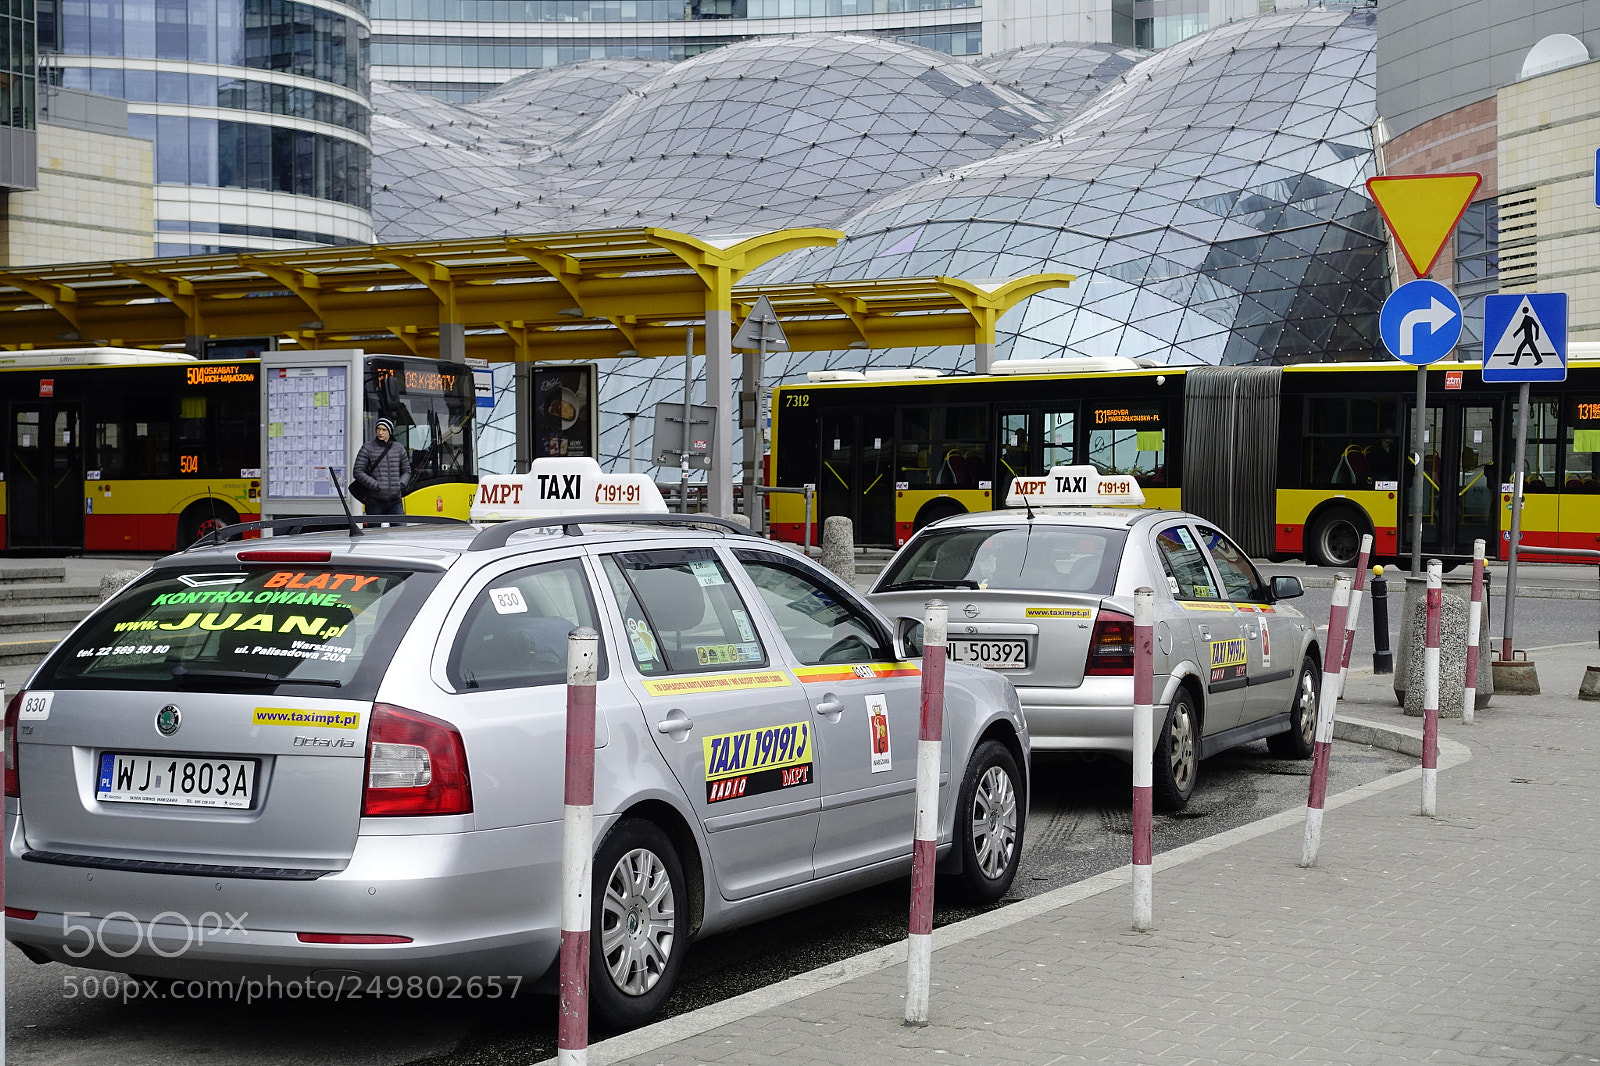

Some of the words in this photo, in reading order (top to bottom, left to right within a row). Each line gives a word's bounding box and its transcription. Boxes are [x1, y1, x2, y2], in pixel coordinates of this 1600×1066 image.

[187, 367, 204, 385] 504
[786, 394, 810, 408] 7312
[1094, 409, 1107, 424] 131
[1577, 403, 1593, 420] 131
[180, 455, 198, 473] 504
[480, 484, 523, 504] MPT
[537, 474, 581, 500] TAXI
[1015, 481, 1046, 495] MPT
[1055, 476, 1087, 493] TAXI
[263, 572, 378, 592] BLATY
[151, 591, 352, 610] KONTROLOWANE...
[498, 593, 519, 607] 830
[1028, 609, 1090, 618] www.taximpt.pl
[113, 612, 348, 639] www.JUAN.pl
[77, 649, 95, 658] tel.
[97, 646, 111, 656] 22
[112, 645, 134, 656] 569
[136, 645, 152, 655] 50
[154, 644, 171, 654] 80
[234, 645, 248, 655] ul.
[252, 646, 321, 661] Palisadowa
[322, 652, 347, 663] 20A
[291, 640, 352, 655] Warszawa
[970, 643, 1024, 663] 50392
[1212, 641, 1227, 664] TAXI
[26, 698, 46, 712] 830
[256, 711, 357, 726] www.taximpt.pl
[293, 735, 356, 748] Octavia
[708, 733, 752, 774] TAXI
[752, 725, 798, 767] 19191
[101, 778, 111, 787] PL
[117, 759, 152, 791] WJ
[167, 761, 248, 797] 1803A
[710, 777, 747, 801] RADIO
[782, 766, 809, 787] MPT
